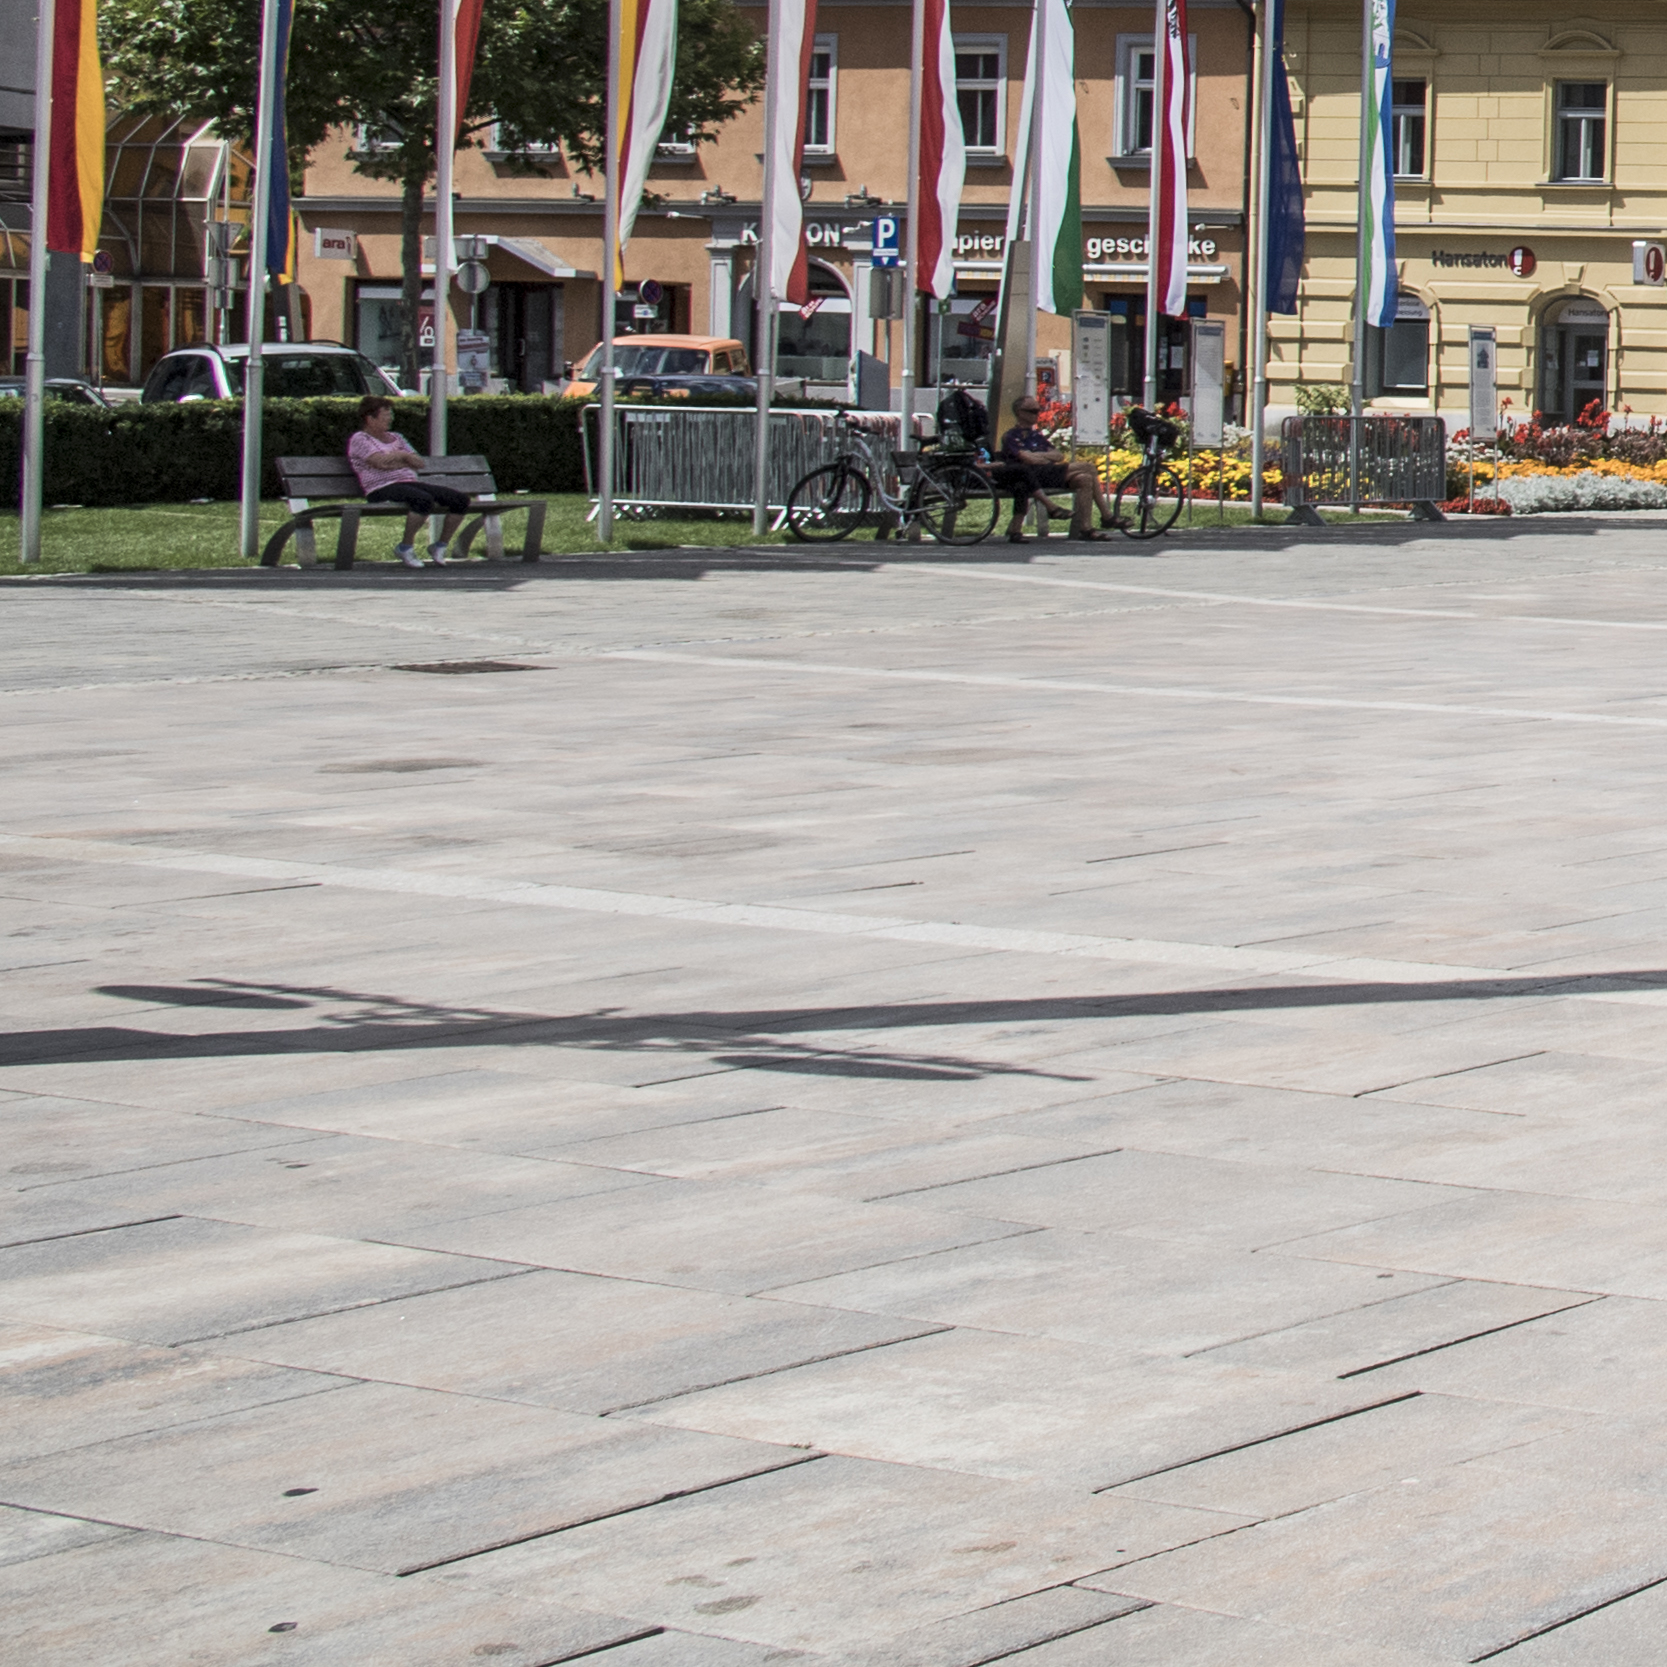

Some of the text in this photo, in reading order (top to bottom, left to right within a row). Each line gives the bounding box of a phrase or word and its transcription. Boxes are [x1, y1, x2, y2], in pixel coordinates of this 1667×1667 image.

[741, 222, 840, 243] KON
[877, 218, 896, 248] P
[322, 238, 345, 249] ara
[952, 230, 1216, 259] pier gescke
[1431, 249, 1509, 269] Hansaton
